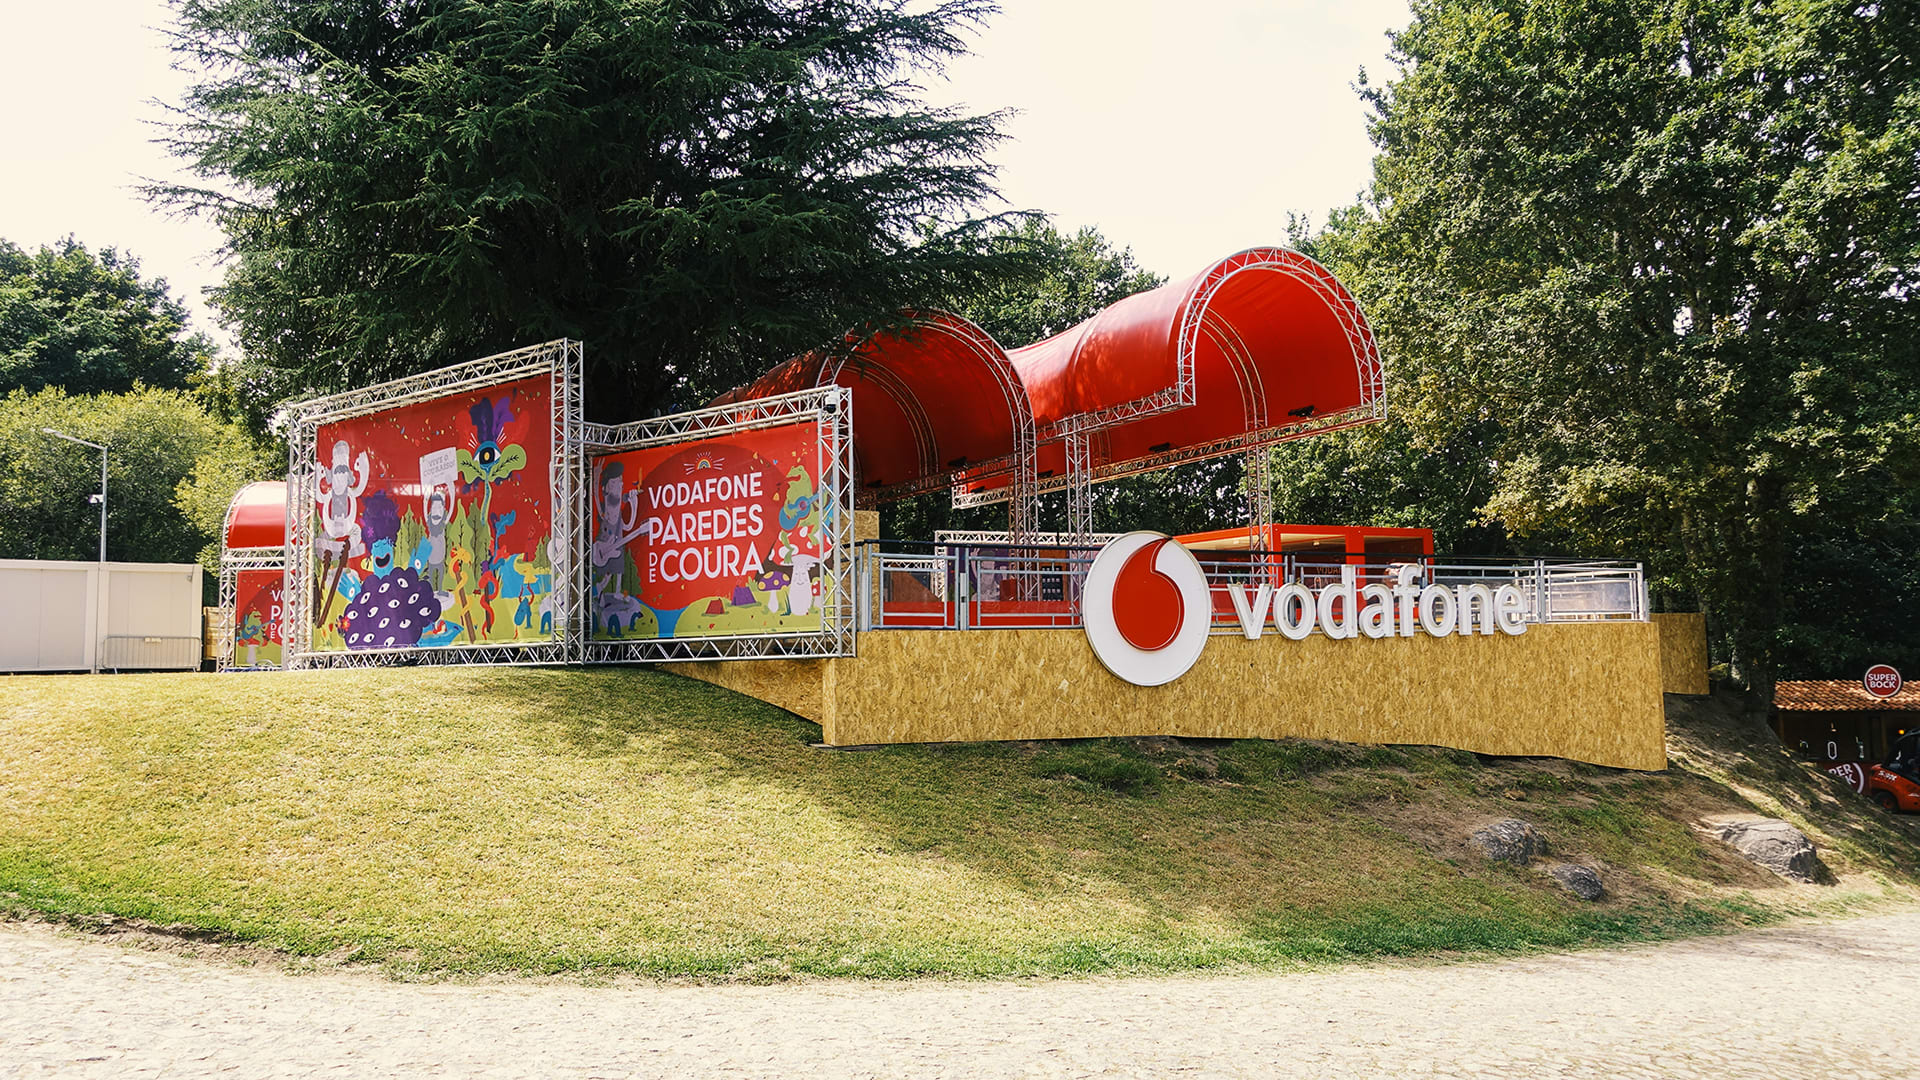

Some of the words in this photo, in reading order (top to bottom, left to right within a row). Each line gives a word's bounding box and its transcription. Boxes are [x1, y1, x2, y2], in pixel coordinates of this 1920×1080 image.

[648, 471, 763, 509] VODAFONE
[648, 503, 764, 547] PAREDES
[649, 552, 658, 583] DE
[660, 541, 765, 583] COURA
[1227, 564, 1528, 640] vodafone
[1868, 673, 1897, 681] SUPER
[1870, 680, 1896, 689] BOCK
[1828, 763, 1853, 776] PER
